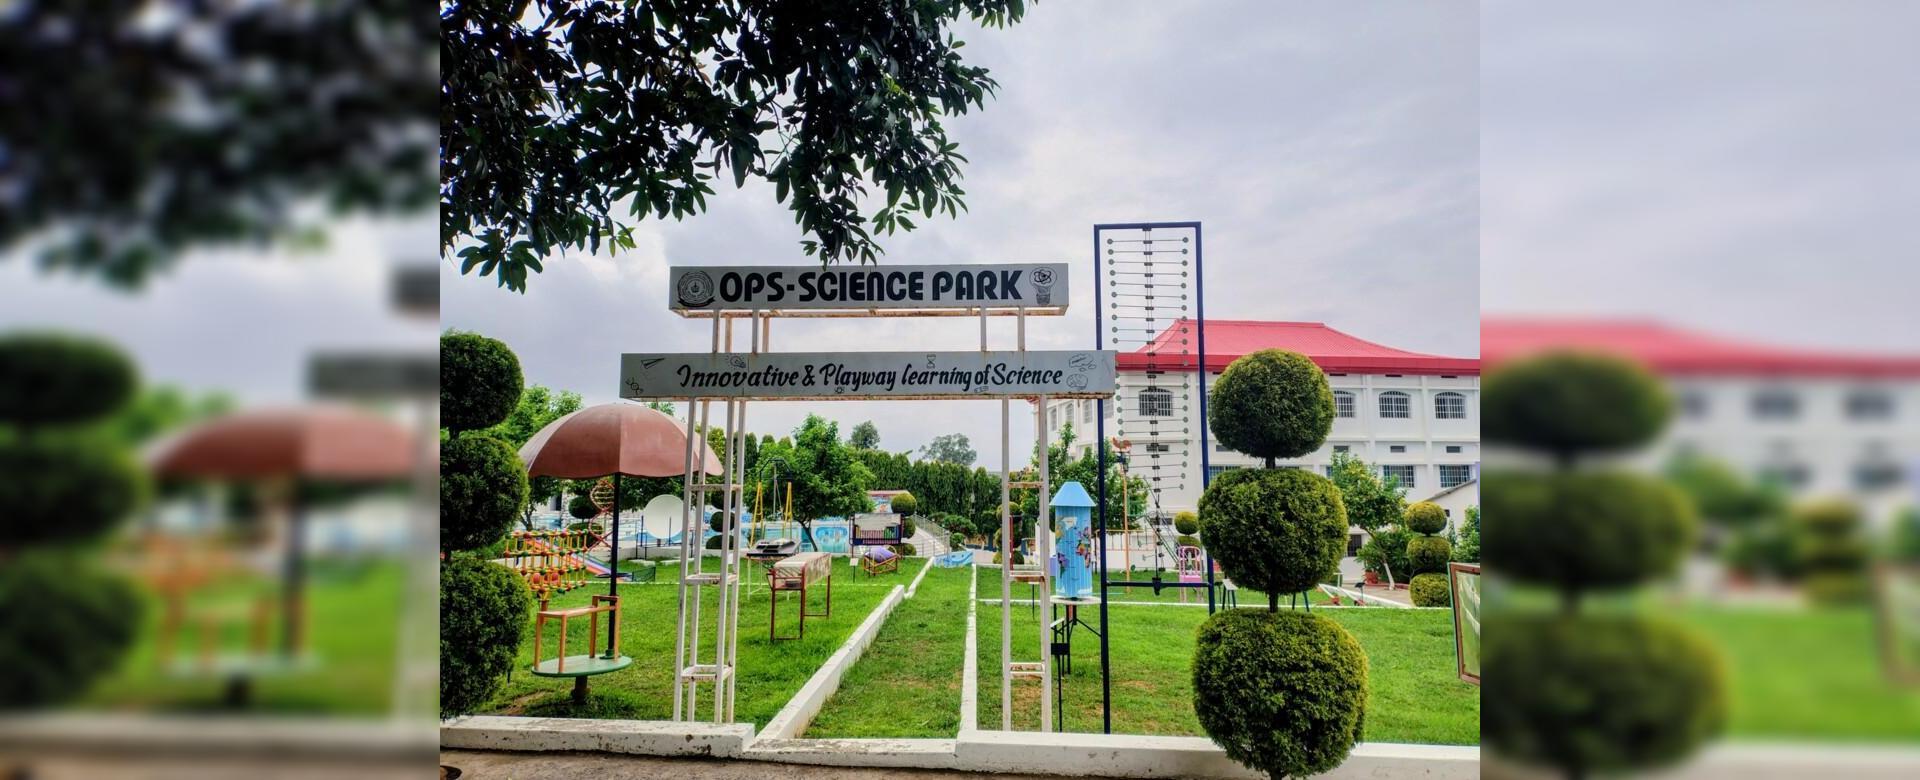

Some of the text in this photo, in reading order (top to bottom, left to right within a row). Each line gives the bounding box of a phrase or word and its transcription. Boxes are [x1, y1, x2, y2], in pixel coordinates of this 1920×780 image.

[719, 271, 923, 302] OPS-SCIENCE
[932, 270, 1023, 301] PARK
[677, 364, 799, 388] Innovative
[801, 364, 816, 387] &
[819, 363, 896, 391] Playway
[974, 363, 992, 386] of
[991, 362, 1063, 386] Science
